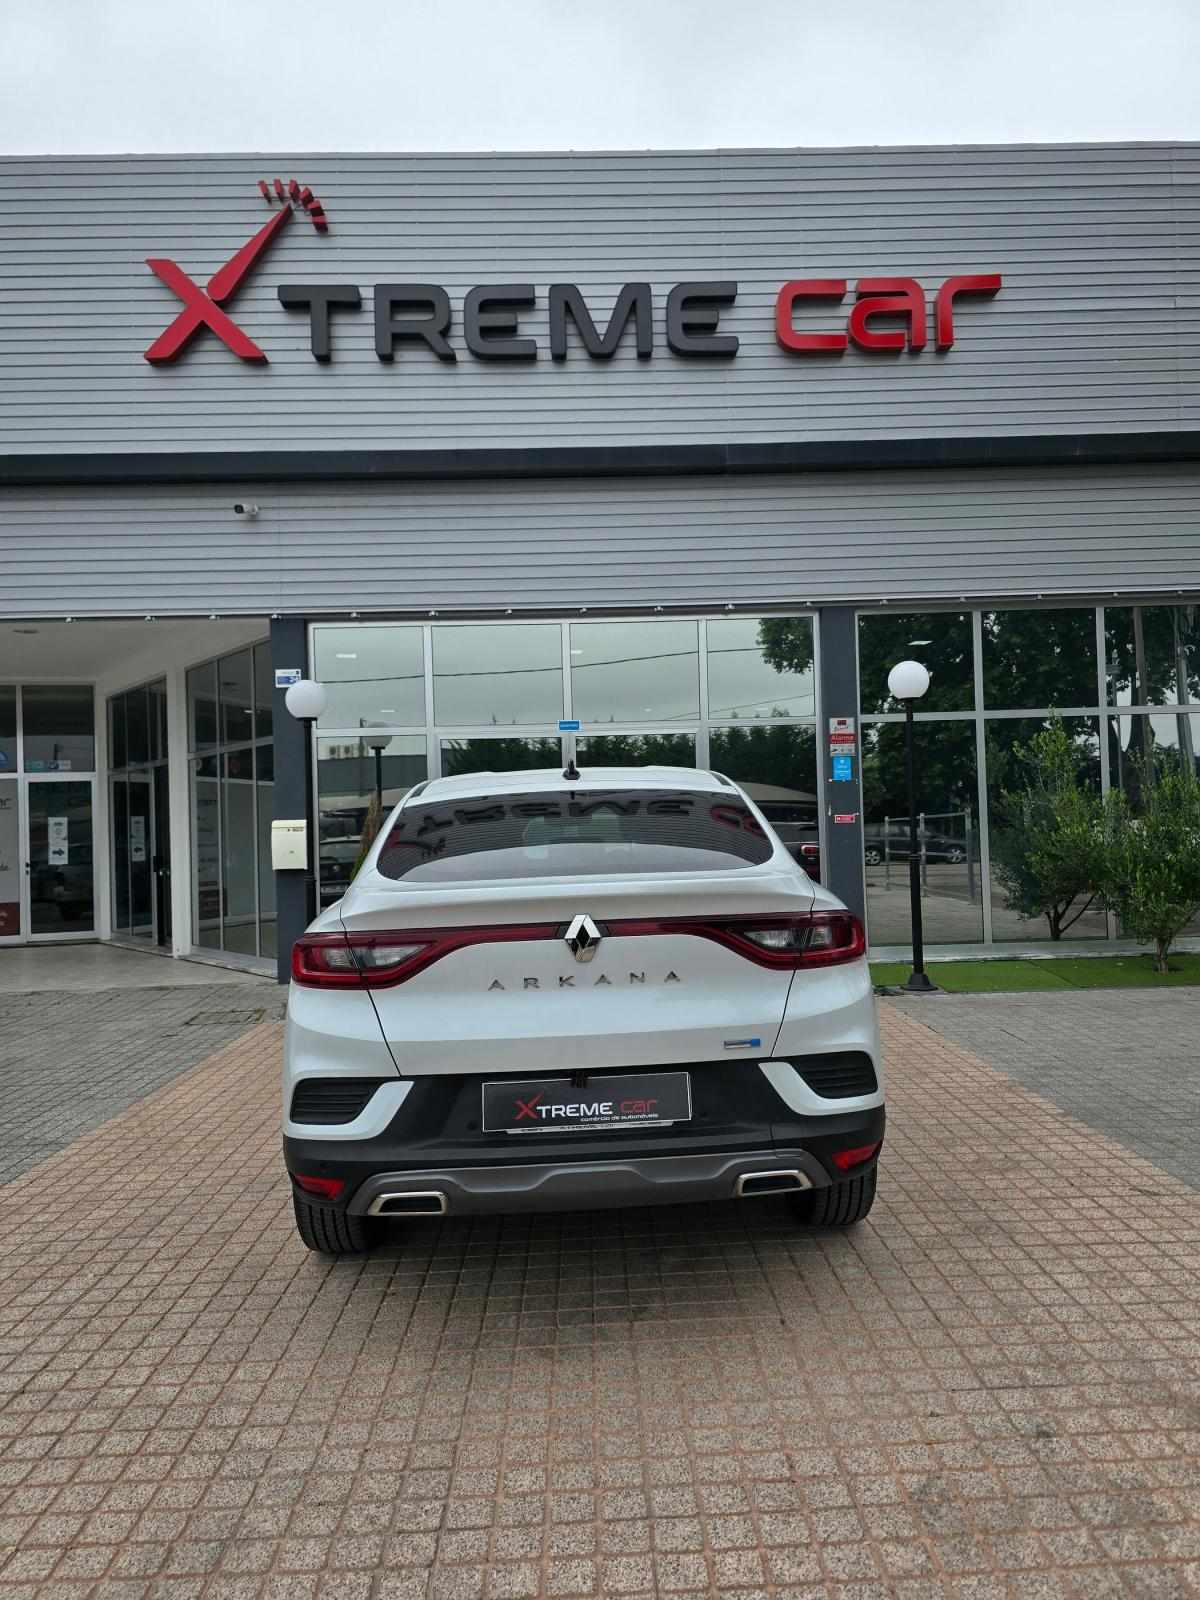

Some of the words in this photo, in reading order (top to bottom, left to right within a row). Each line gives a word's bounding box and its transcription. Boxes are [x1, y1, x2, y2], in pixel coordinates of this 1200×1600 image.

[144, 201, 741, 365] XTREME
[487, 970, 681, 991] ARKANA
[514, 1091, 613, 1120] XTREME
